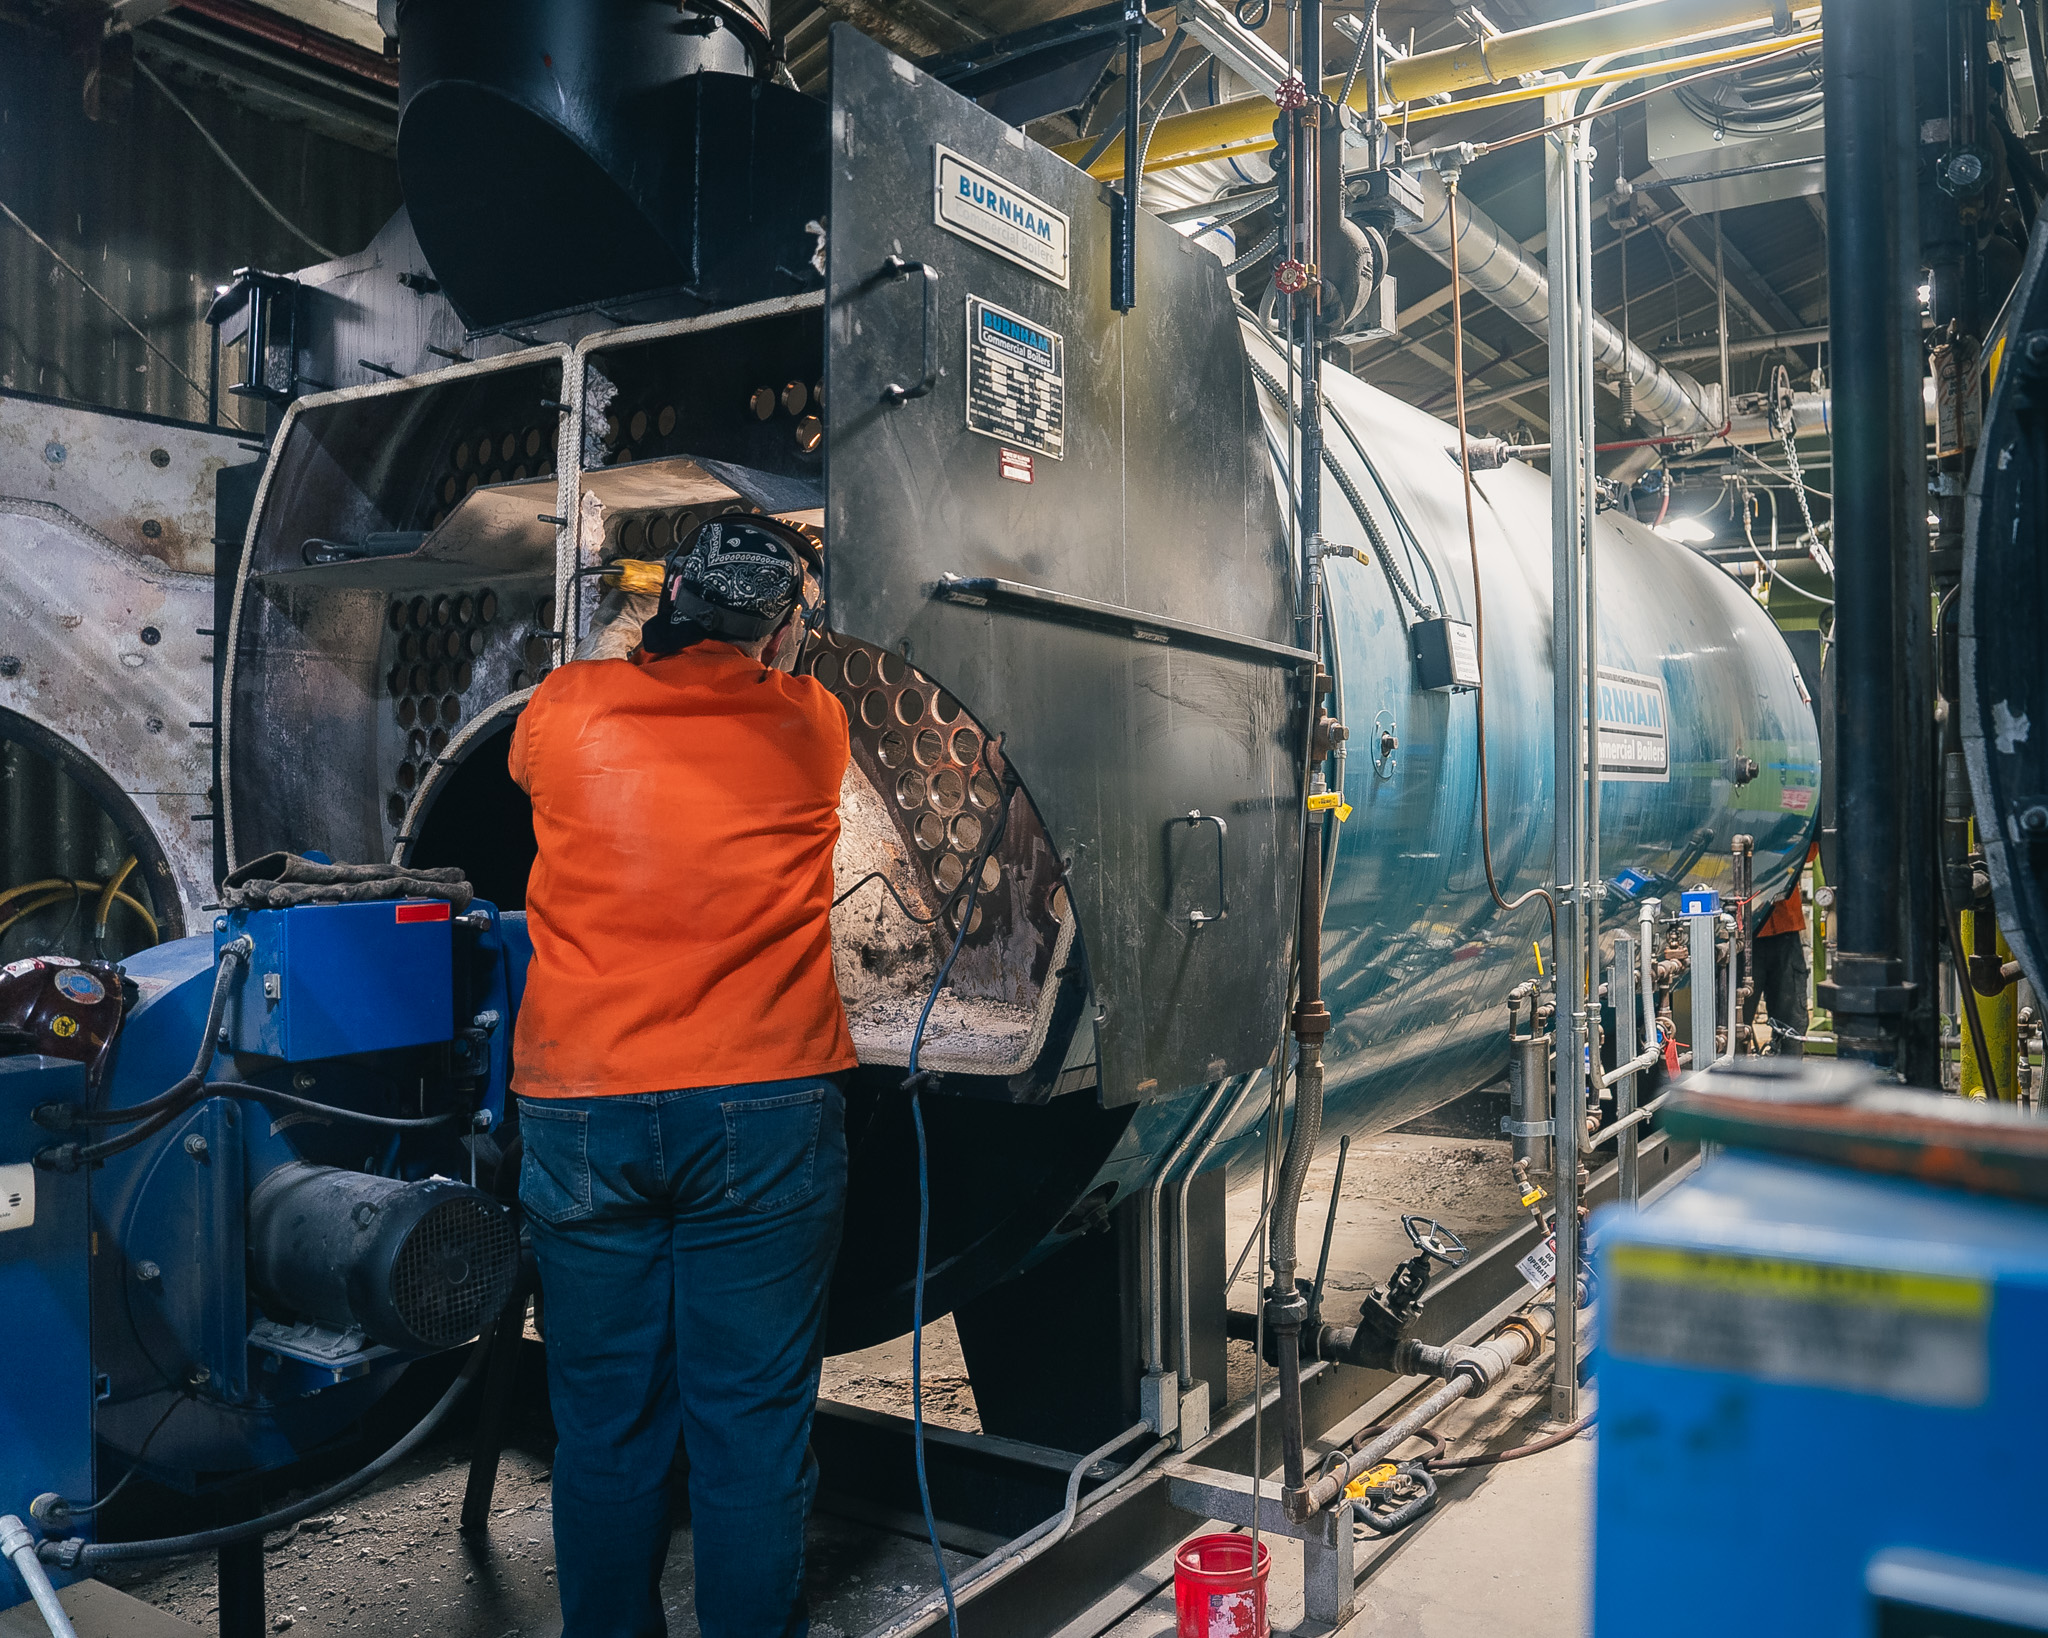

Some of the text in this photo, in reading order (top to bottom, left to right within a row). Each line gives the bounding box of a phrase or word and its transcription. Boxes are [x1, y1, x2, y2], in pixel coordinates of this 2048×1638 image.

[960, 175, 1052, 241] BURNHAM
[956, 203, 1054, 265] Commercial Boilers
[984, 311, 1049, 353] BURNHAM
[983, 331, 1051, 368] Commercial Boilers
[1637, 740, 1665, 762] Boilers
[1527, 1255, 1550, 1281] OPERATE
[1538, 1256, 1550, 1269] NOT
[1545, 1253, 1554, 1263] DO
